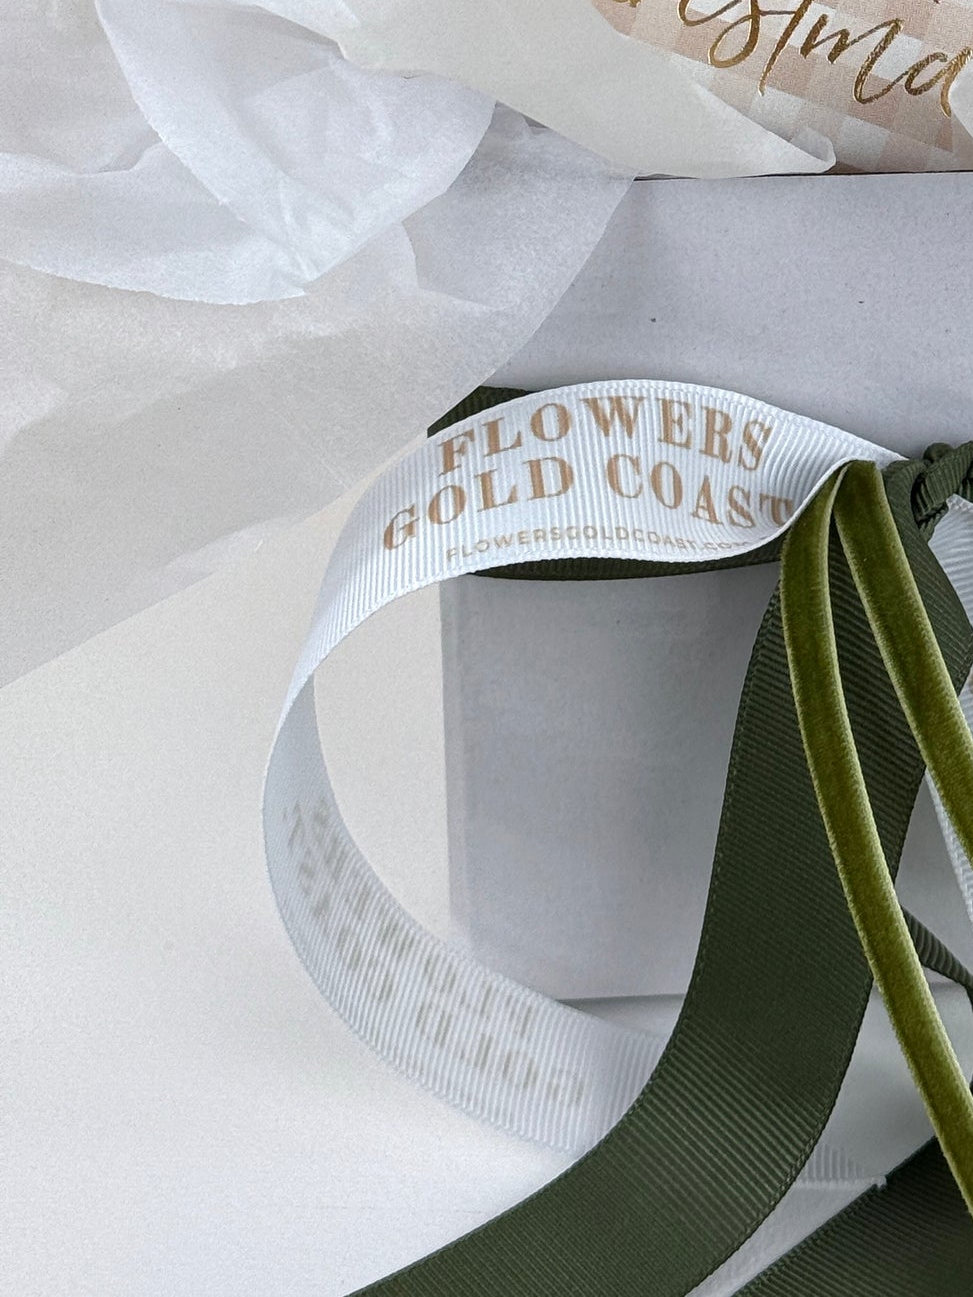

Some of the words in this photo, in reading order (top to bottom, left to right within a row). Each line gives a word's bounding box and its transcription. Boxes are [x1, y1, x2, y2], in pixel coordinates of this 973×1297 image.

[437, 395, 772, 478] FLOWERS
[383, 456, 575, 551] GOLD
[605, 453, 794, 529] COAST
